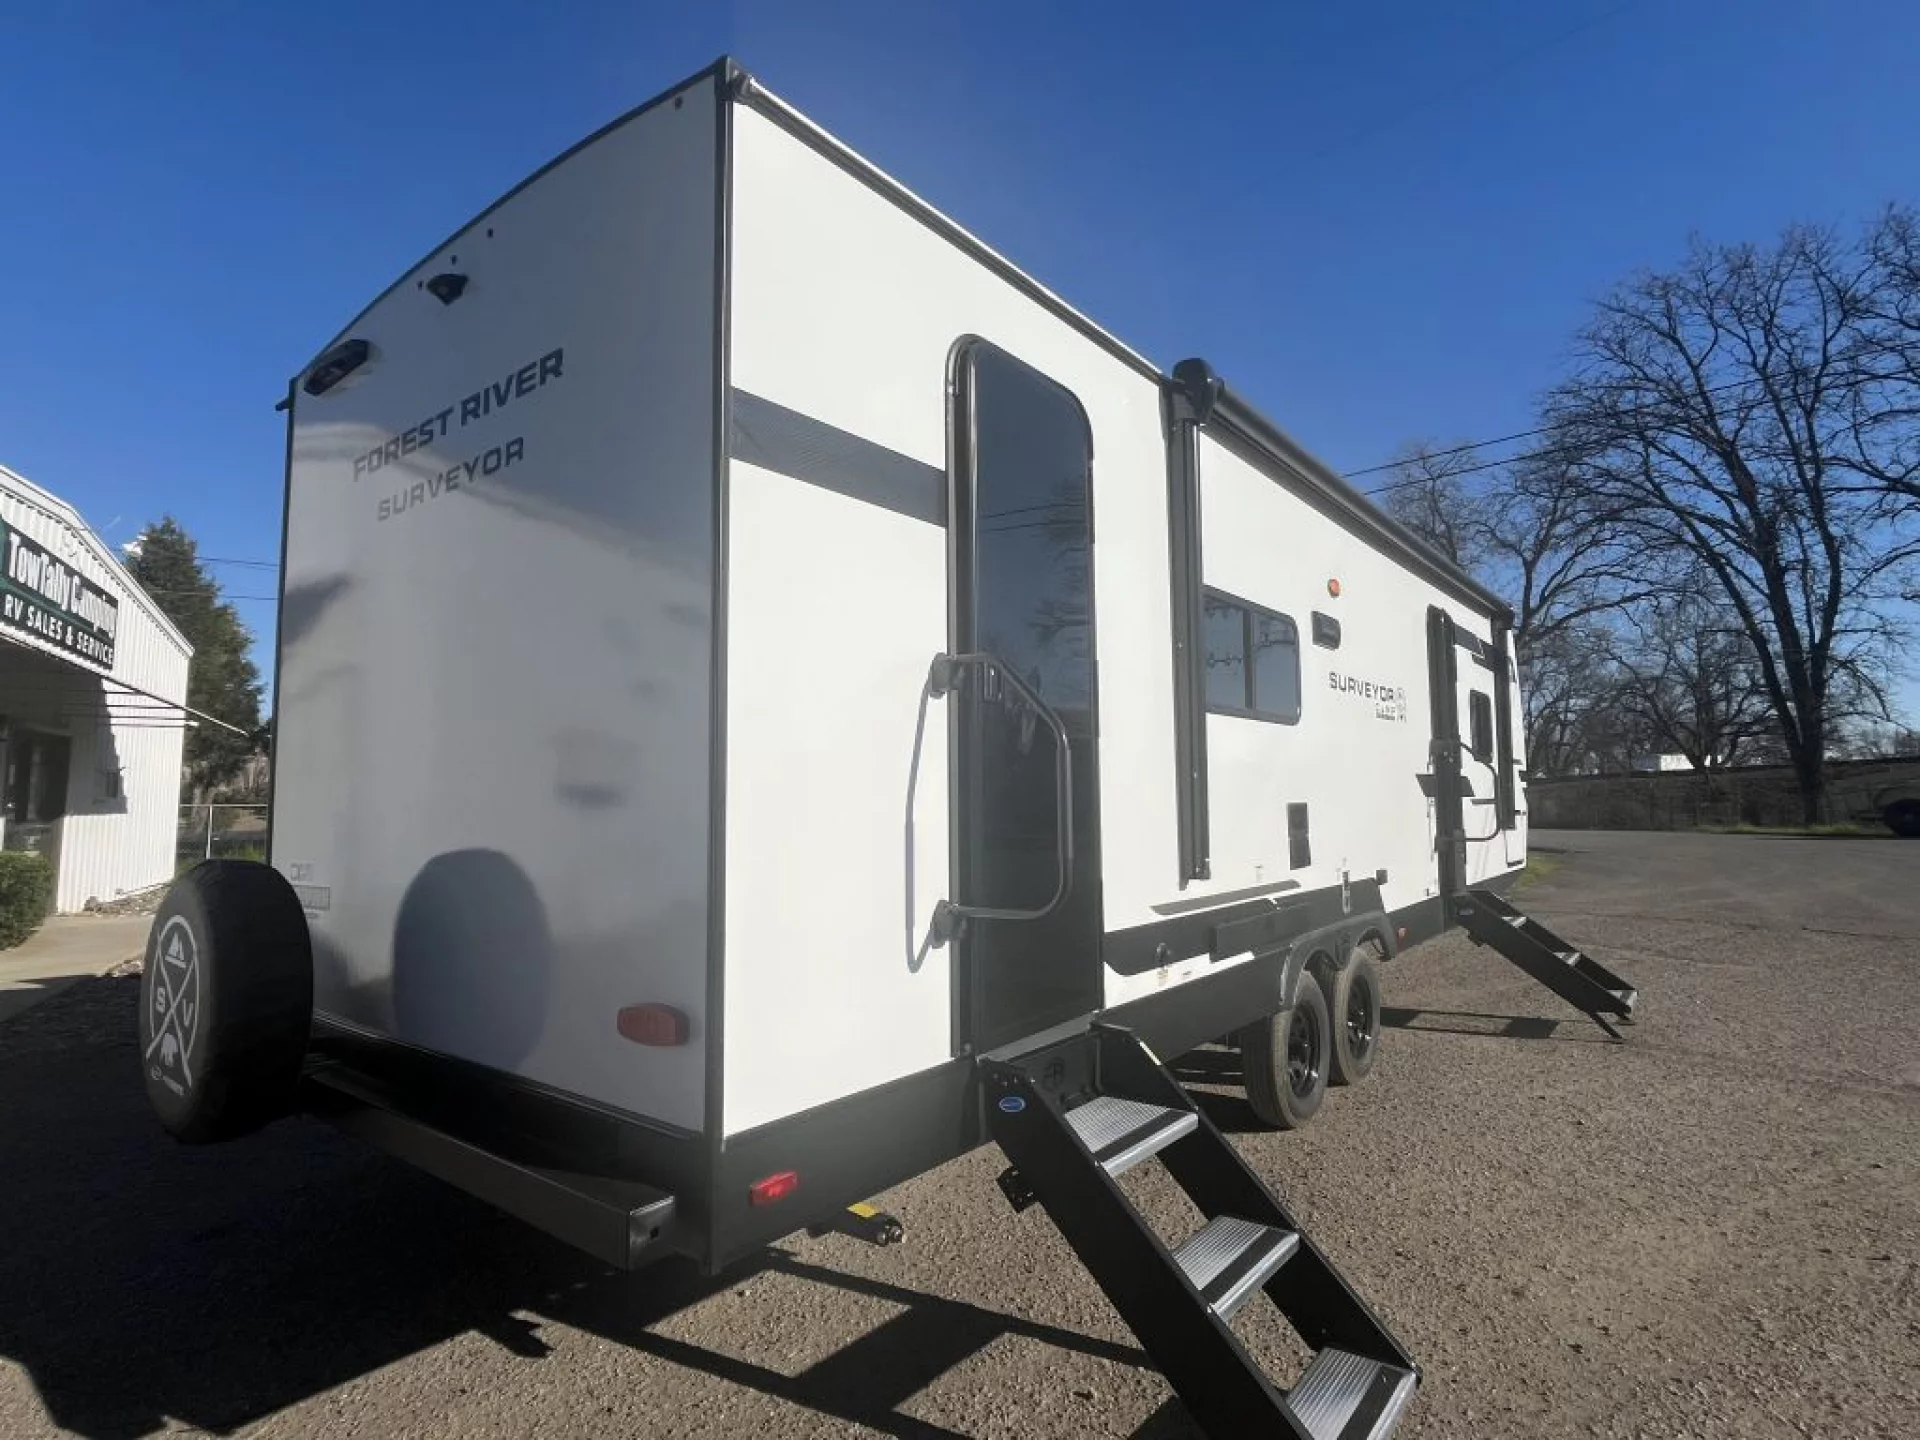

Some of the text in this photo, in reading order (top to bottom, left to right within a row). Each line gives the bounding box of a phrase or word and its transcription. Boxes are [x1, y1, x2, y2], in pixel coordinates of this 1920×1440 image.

[353, 348, 564, 482] FOREST RIVER
[377, 436, 524, 521] SURVEYOR
[4, 594, 113, 665] RV SALES & SERVICE
[1328, 671, 1394, 702] SURVEYOR
